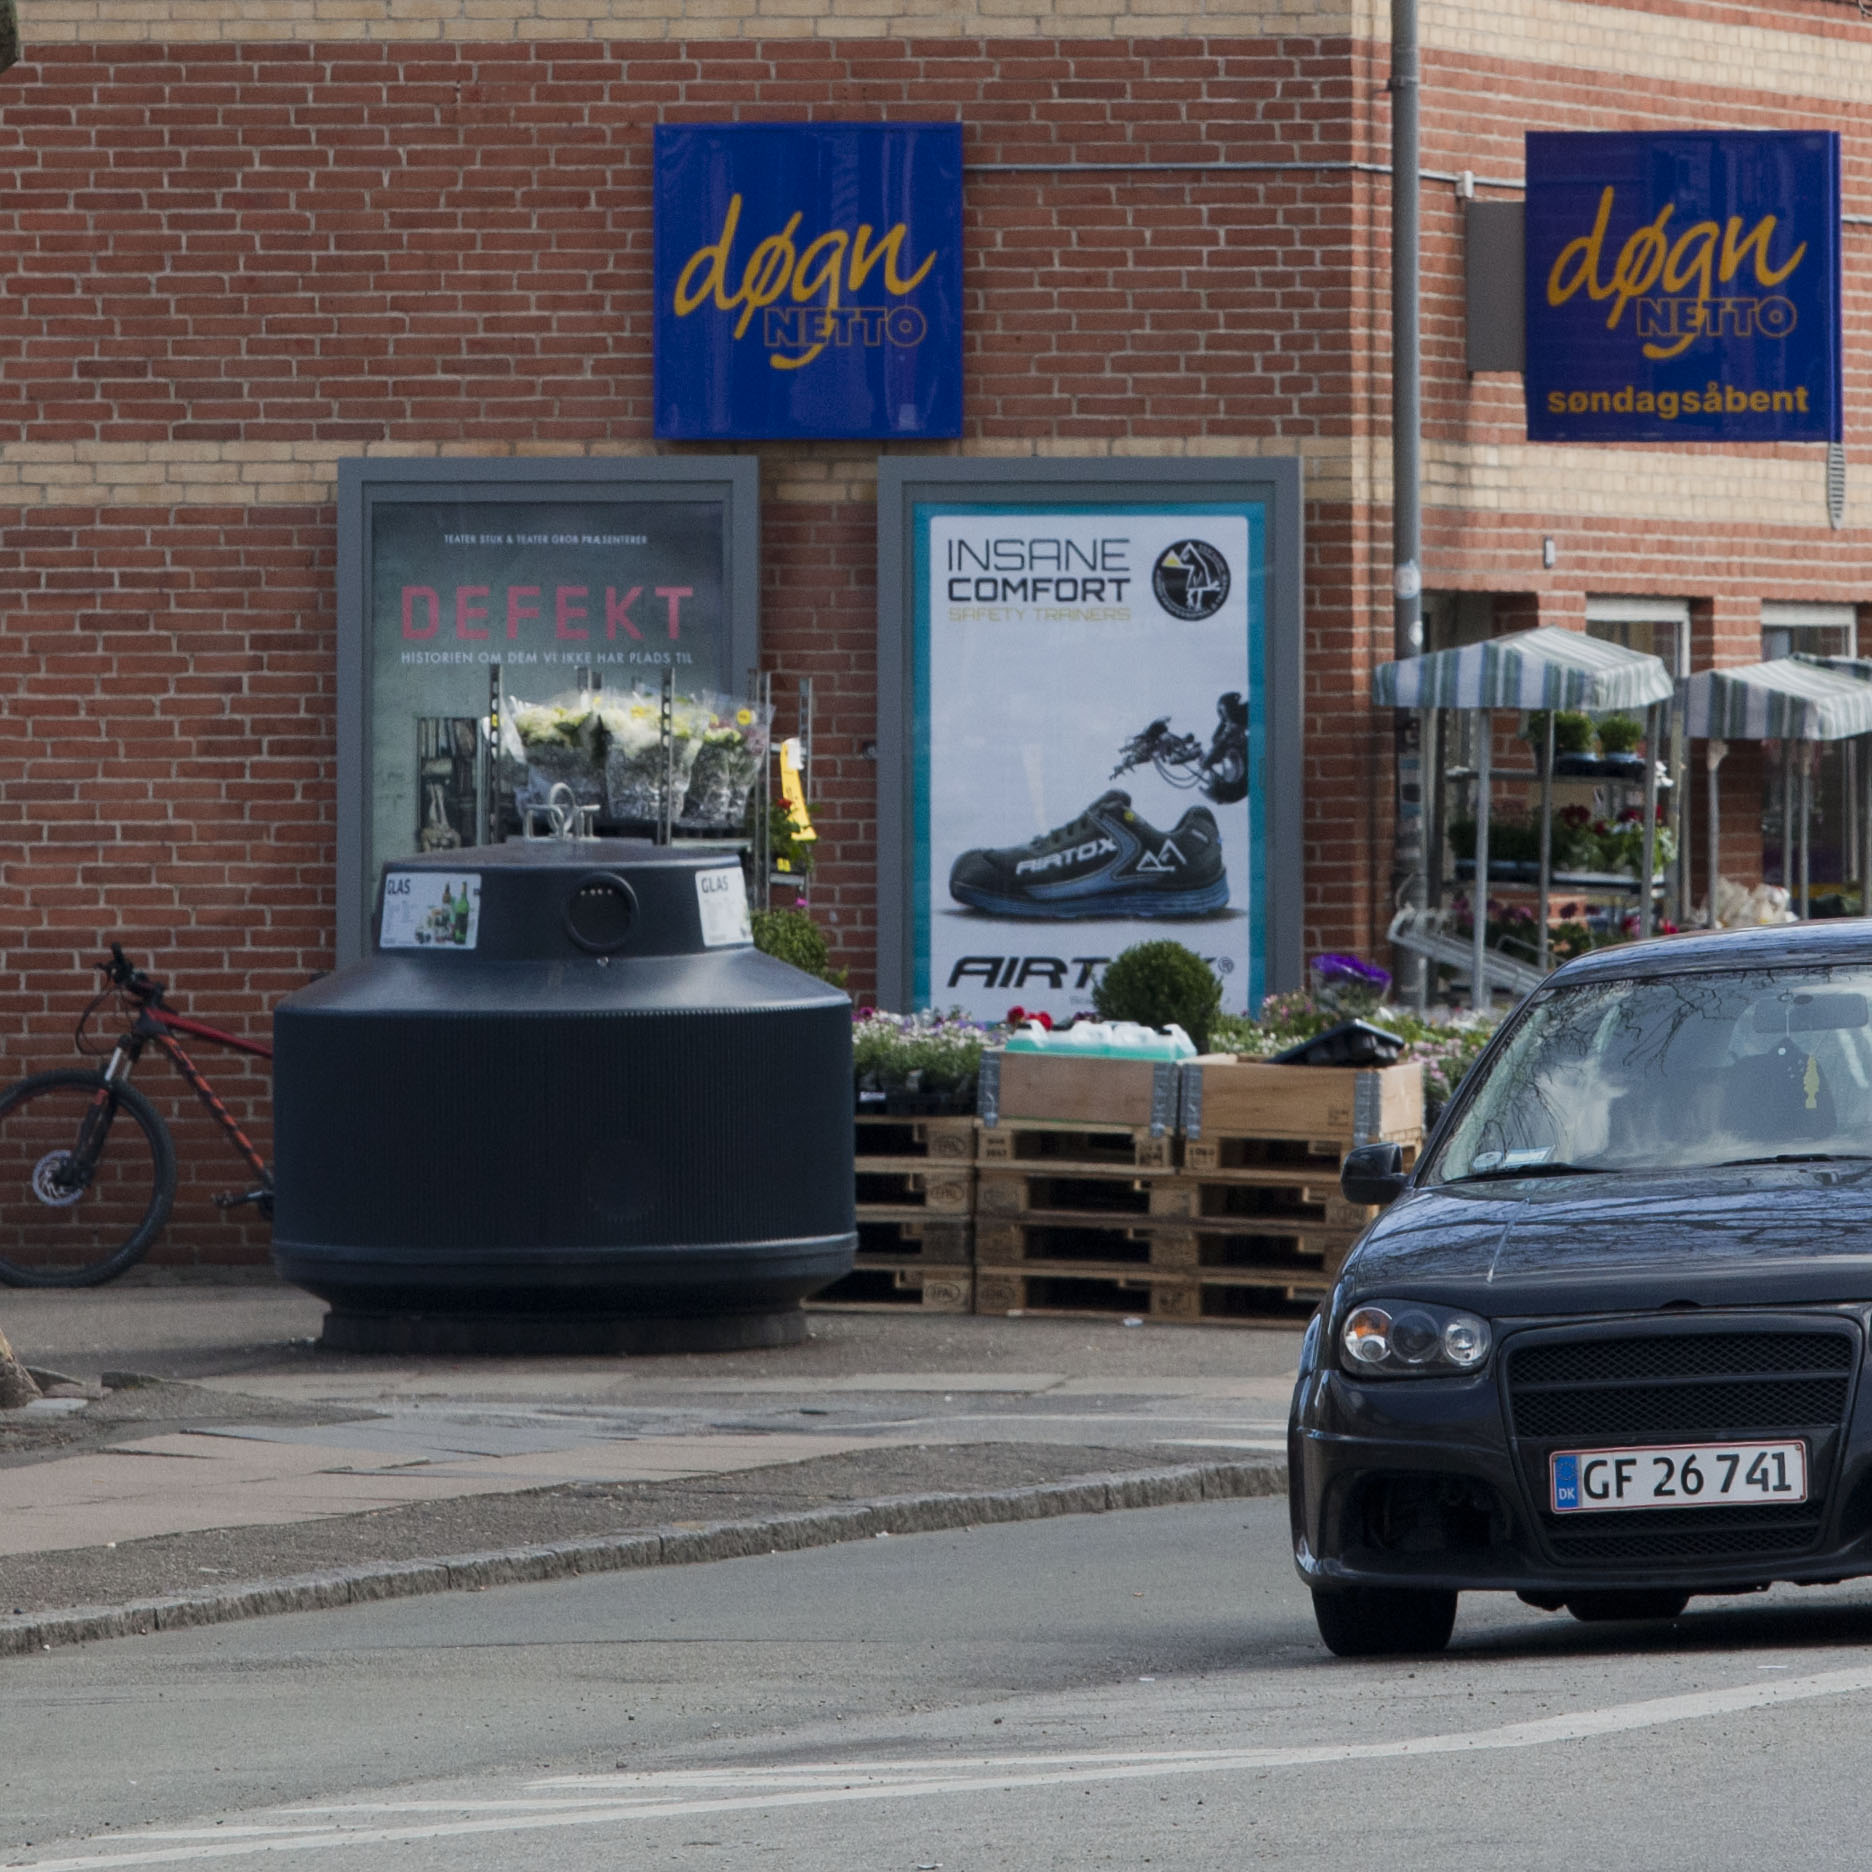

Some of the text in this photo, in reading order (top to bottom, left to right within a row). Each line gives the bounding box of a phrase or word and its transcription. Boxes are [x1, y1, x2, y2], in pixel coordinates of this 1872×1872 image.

[673, 193, 938, 370] døgn
[1546, 185, 1808, 360] døgn
[763, 305, 927, 348] NETTO
[1636, 295, 1797, 338] NETTO
[1547, 381, 1809, 420] søndagsåbent
[444, 534, 476, 545] TEATER
[516, 534, 549, 545] TEATER
[948, 539, 1130, 572] INSANE
[948, 577, 1131, 602] COMFORT
[401, 585, 694, 641] DEFEKT
[948, 607, 1131, 623] SAFETY TRAINERS
[400, 651, 693, 665] HISTORIEN OM DEM VI IKKE HAR PLADS TIL
[1016, 837, 1118, 876] AIRTOX
[386, 878, 411, 896] GLAS
[701, 874, 730, 894] GLAS
[947, 956, 1217, 989] AIRT
[1583, 1451, 1792, 1500] GF 26 741
[1559, 1488, 1576, 1501] DK
